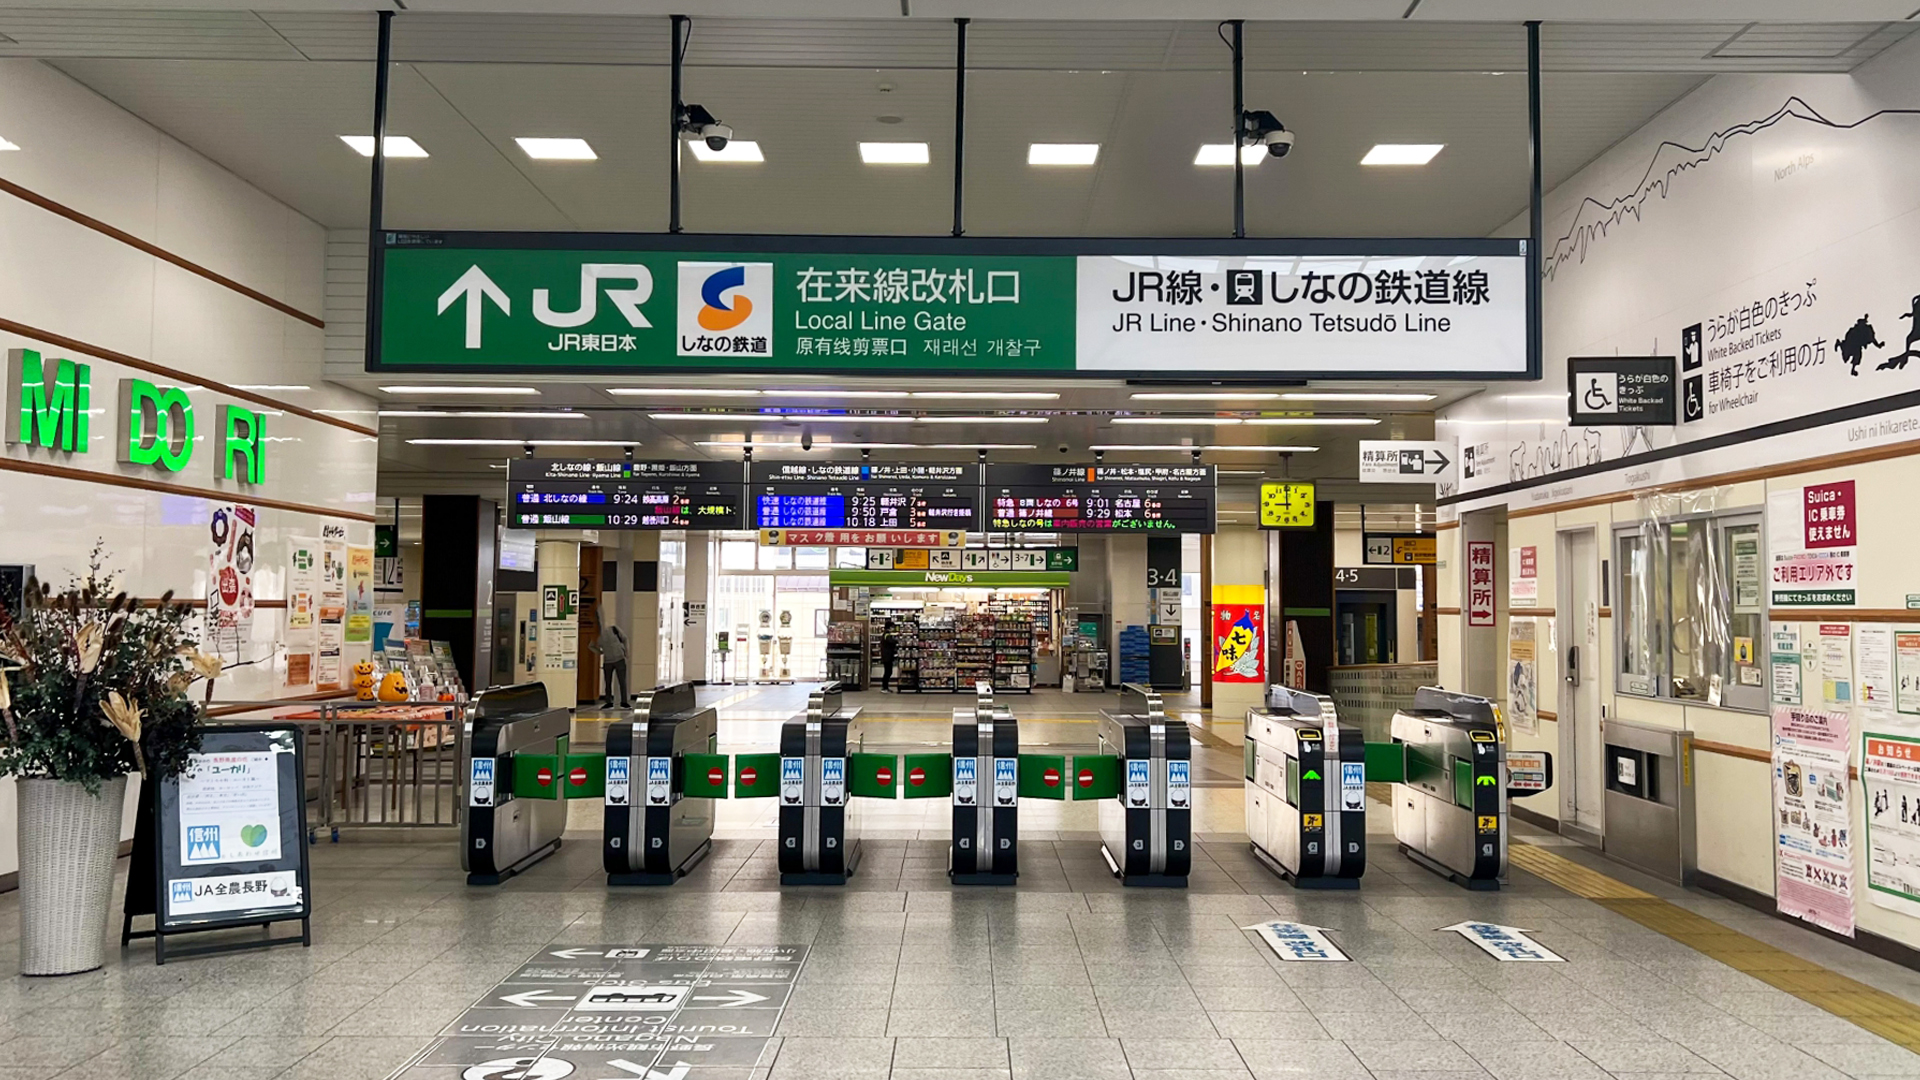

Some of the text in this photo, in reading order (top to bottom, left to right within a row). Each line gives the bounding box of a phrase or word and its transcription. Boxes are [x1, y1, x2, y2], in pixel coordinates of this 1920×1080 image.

[796, 267, 1020, 304] 在来線改札口
[1270, 269, 1490, 305] しなの鉄道線
[533, 263, 653, 327] JR
[1707, 278, 1818, 343] うらが白色のきっぷ
[795, 310, 967, 331] Local Line Gate
[1112, 313, 1142, 332] JR
[1310, 313, 1397, 332] Tetsudō
[1405, 312, 1451, 332] Line
[558, 334, 637, 352] JR東日本
[682, 336, 767, 353] しなの鉄道
[796, 337, 907, 356] 原有线剪票口
[923, 339, 1042, 357] 재래선 개찰구
[1707, 327, 1782, 362] White Backed Tickets
[1707, 336, 1828, 395] 車椅子をご利用の方
[1618, 374, 1669, 384] うらが白色の
[1618, 385, 1645, 395] きっぷ
[1618, 405, 1644, 413] Tickets
[1638, 397, 1664, 405] Backed
[1708, 391, 1759, 415] for Wheelchair
[1848, 426, 1868, 442] Ushi
[1869, 424, 1878, 439] ni
[1363, 450, 1398, 462] 精算所
[521, 494, 539, 504] 普通
[543, 494, 588, 504] 北しなの線
[613, 494, 638, 504] 9:24
[783, 496, 827, 506] しなの鉄道線
[851, 496, 876, 507] 9:25
[880, 496, 907, 507] 軽井沢
[997, 498, 1014, 508] 特急
[1086, 498, 1110, 508] 9:01
[1114, 498, 1141, 508] 名古屋
[521, 515, 539, 525] 普通
[543, 515, 570, 525] 飯山線
[607, 515, 638, 525] 10:29
[783, 507, 827, 516] しなの鉄道線
[851, 507, 876, 517] 9:50
[1086, 509, 1111, 519] 9:29
[1114, 509, 1132, 519] 松本
[1808, 505, 1845, 523] IC 乗車券
[783, 517, 827, 527] しなの鉄道線
[846, 517, 876, 527] 10:18
[880, 517, 898, 527] 上田
[1808, 524, 1851, 542] 使えません
[1383, 545, 1390, 555] 2
[925, 572, 973, 584] NewDays
[1472, 547, 1492, 606] 精算所
[1773, 563, 1854, 583] ご利用エリア外です
[1222, 631, 1246, 661] 七味
[188, 827, 220, 843] 信州
[194, 879, 268, 897] JA全農長野
[560, 1015, 668, 1026] Center
[460, 1024, 753, 1035] Tourist Information
[497, 1033, 701, 1044] Nagano City
